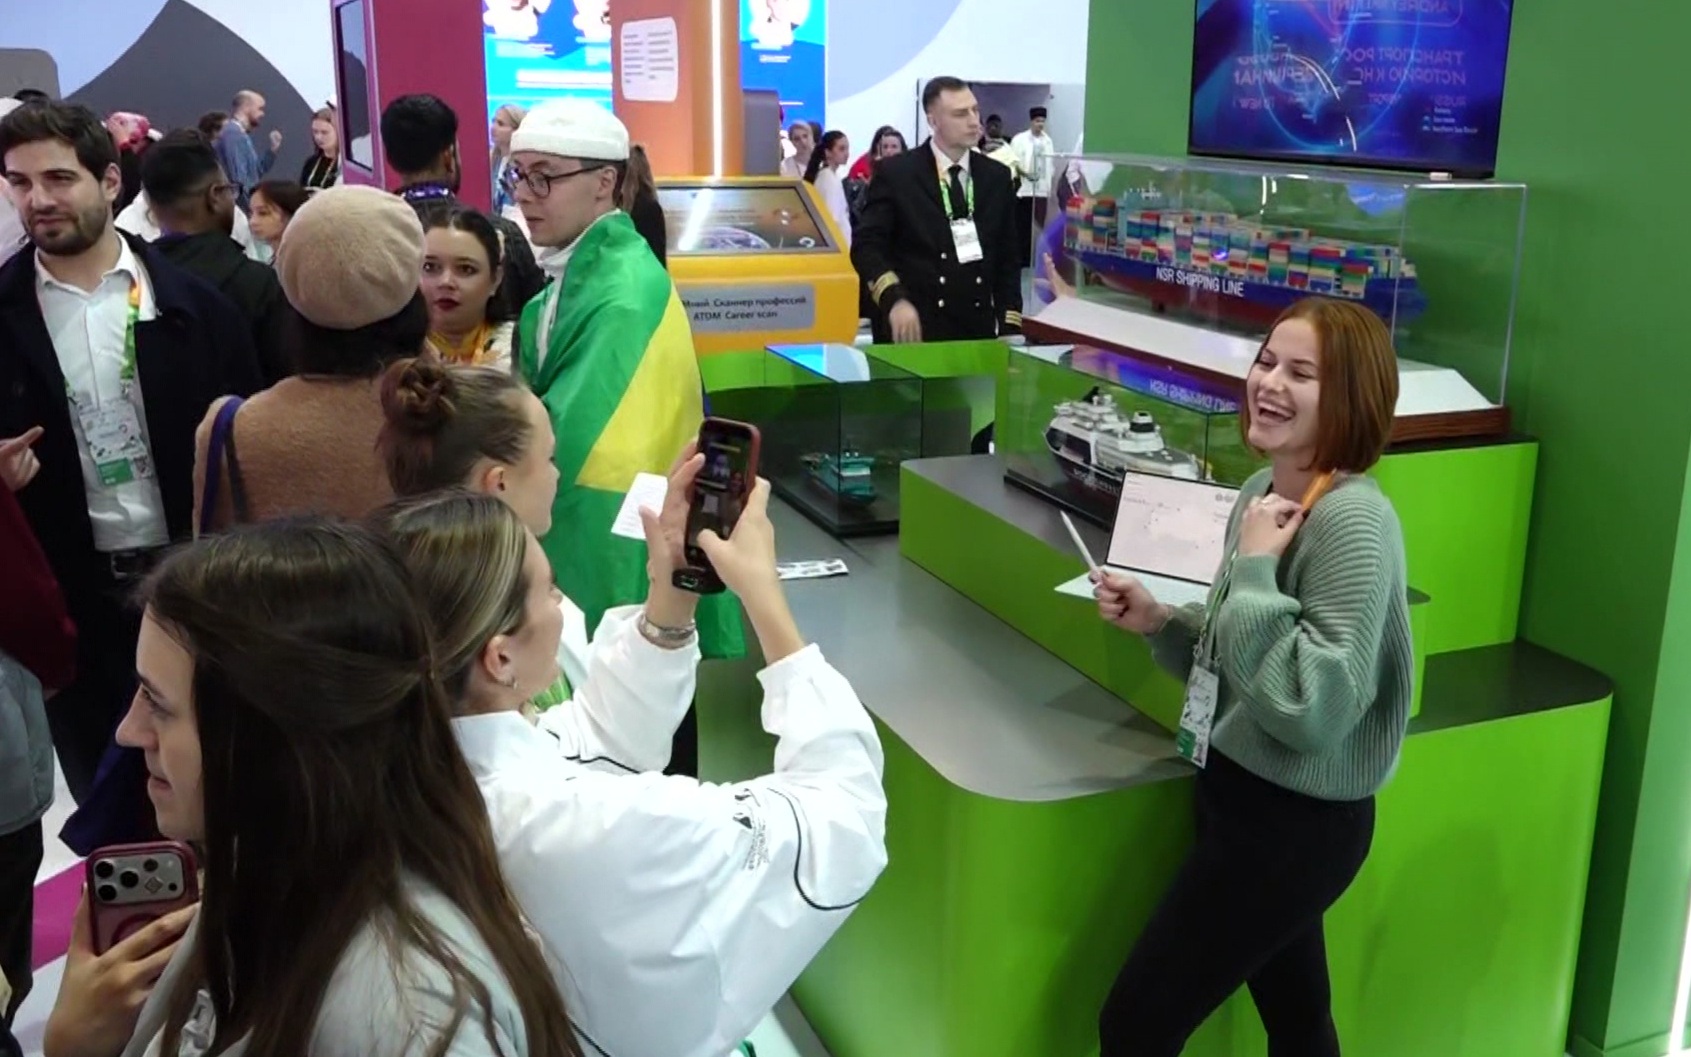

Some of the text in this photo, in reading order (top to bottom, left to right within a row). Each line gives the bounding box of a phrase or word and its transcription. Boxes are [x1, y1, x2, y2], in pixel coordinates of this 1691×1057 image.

[1156, 266, 1244, 297] NSR SHIPPING LINE
[725, 310, 754, 320] Career
[757, 310, 778, 319] scan
